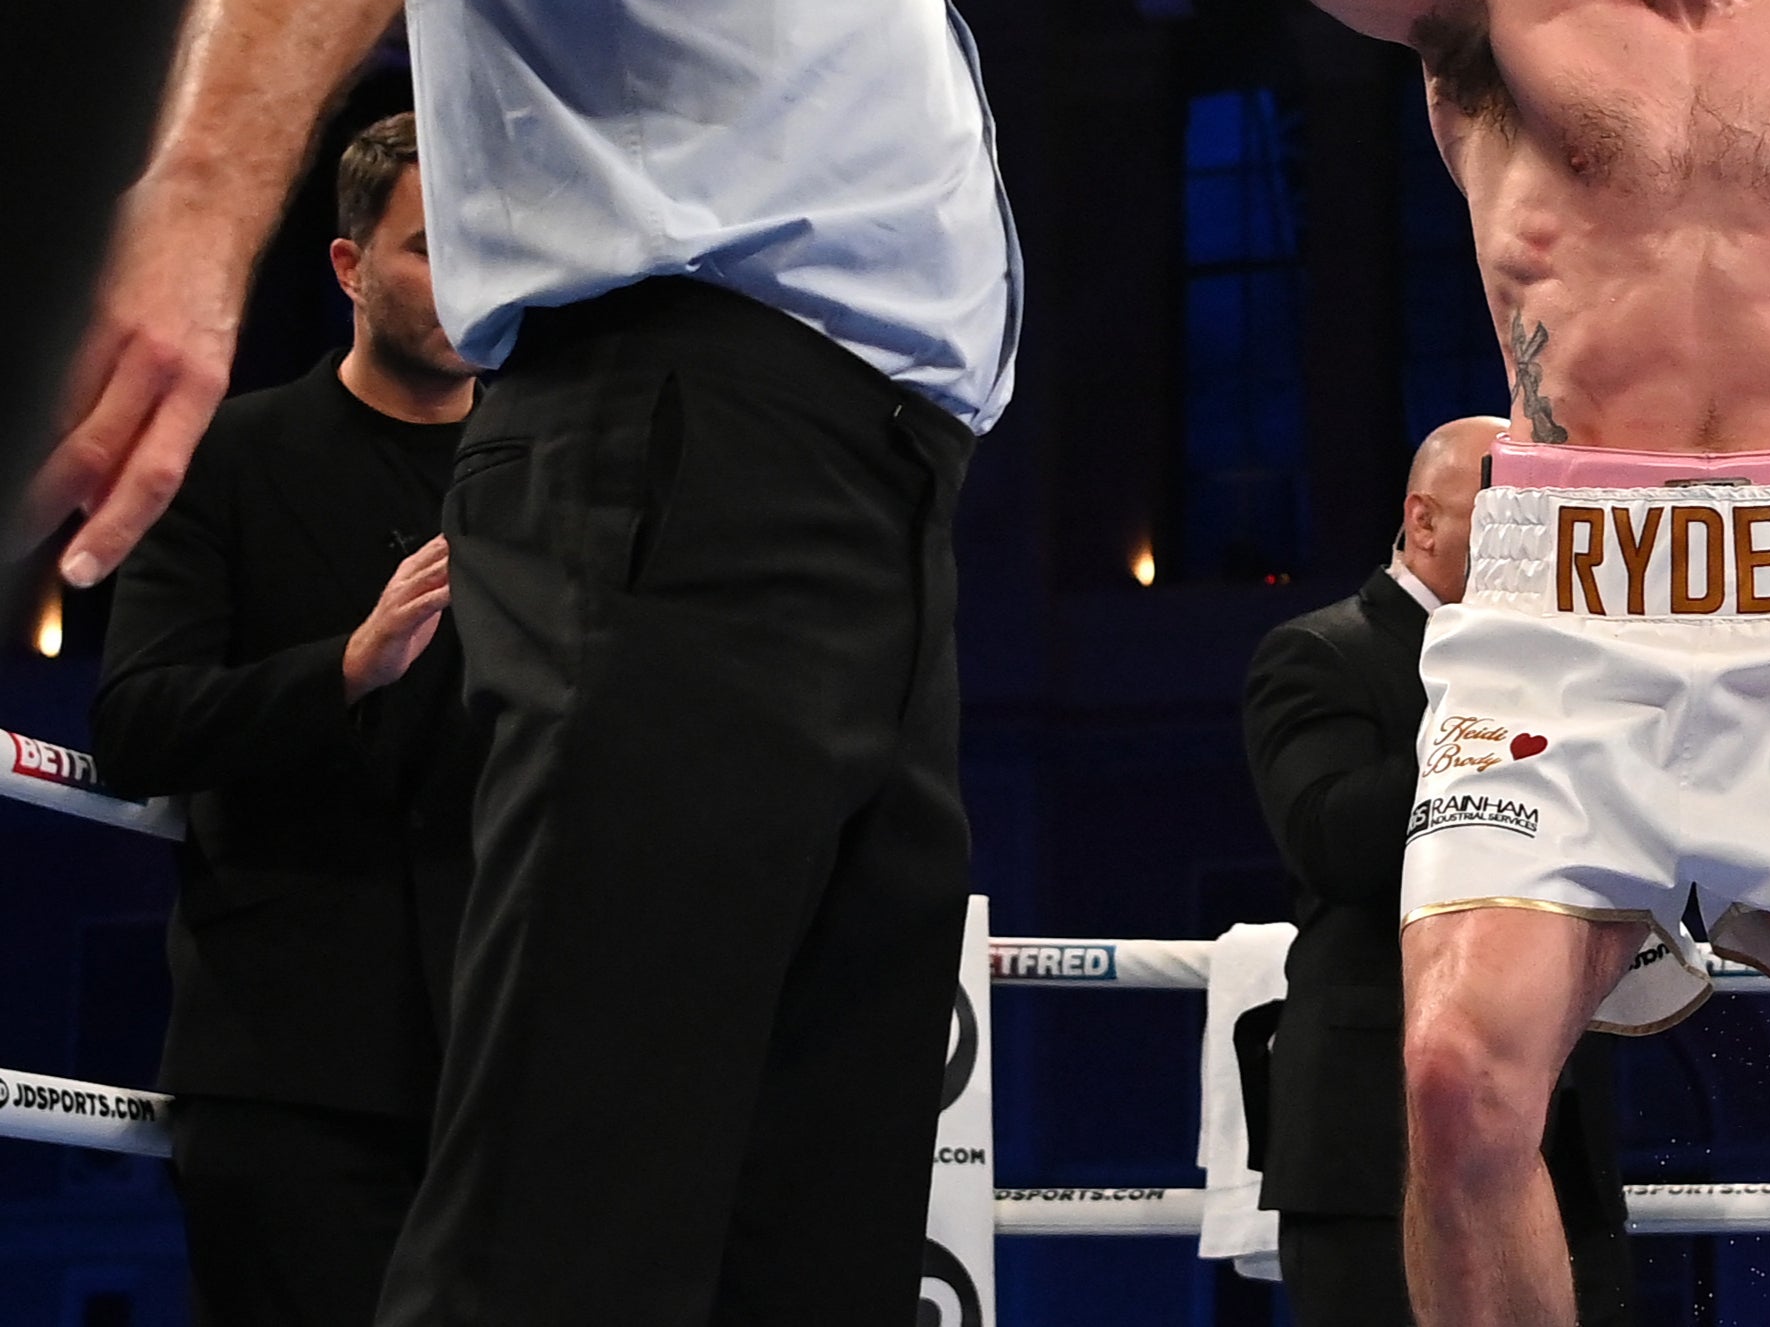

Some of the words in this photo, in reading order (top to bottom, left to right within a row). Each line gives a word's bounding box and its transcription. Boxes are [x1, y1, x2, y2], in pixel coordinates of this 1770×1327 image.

[1433, 716, 1509, 746] Heidi
[1422, 743, 1503, 778] Brody
[1430, 811, 1485, 828] NDUSTRIAL
[1485, 812, 1538, 833] SERVICES
[1432, 795, 1539, 823] RAINHAM
[12, 1082, 156, 1121] JDSPORTS.COM
